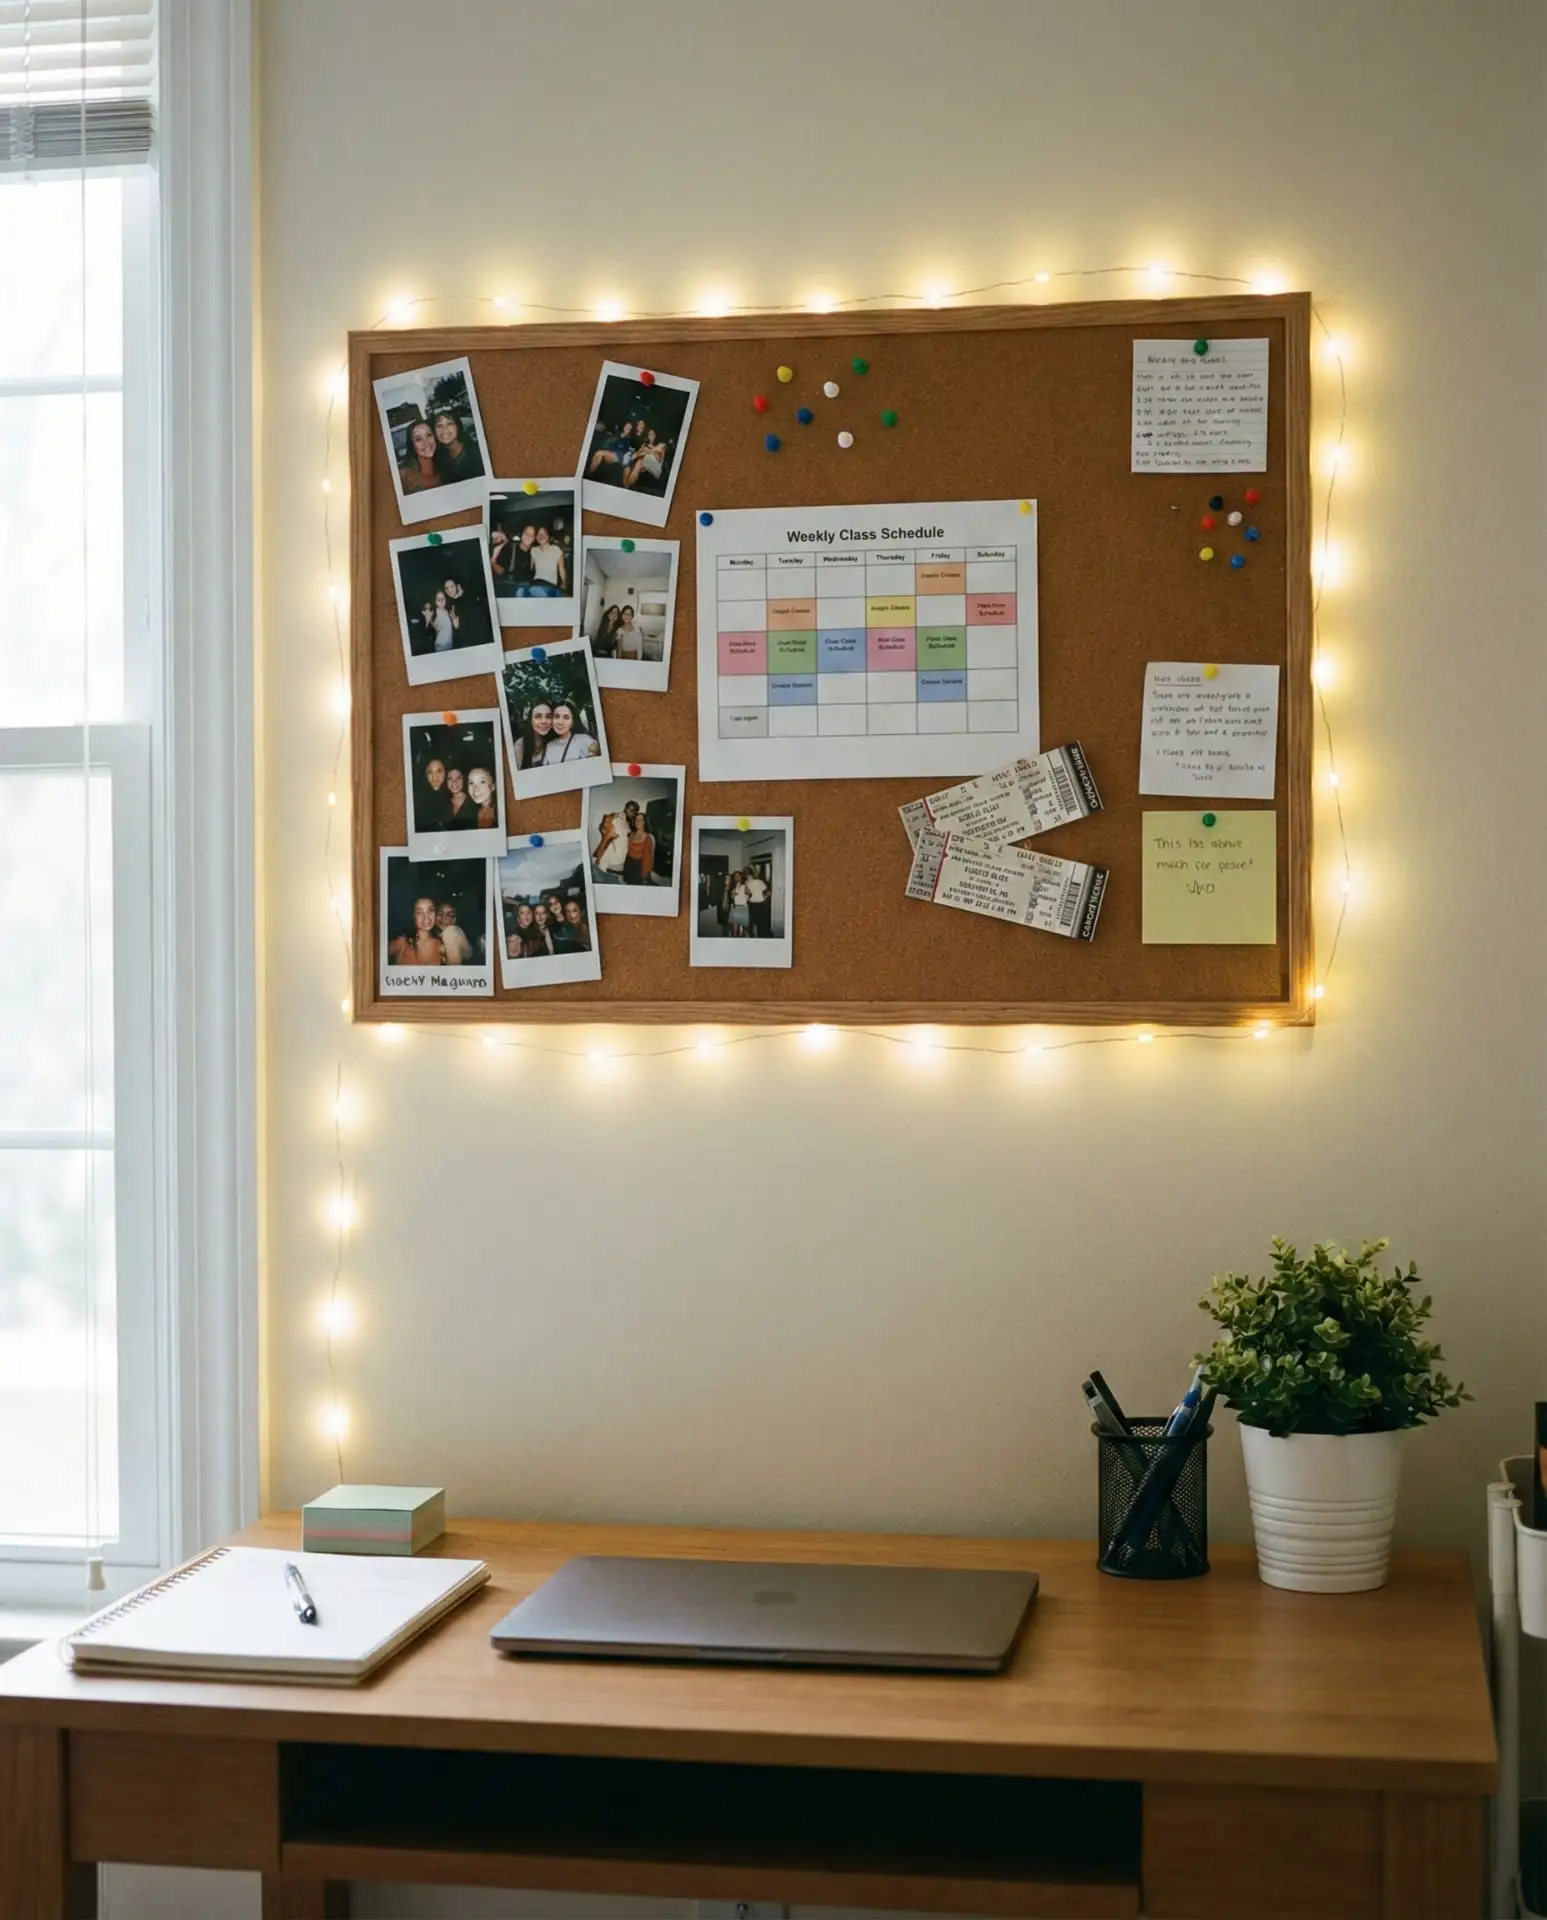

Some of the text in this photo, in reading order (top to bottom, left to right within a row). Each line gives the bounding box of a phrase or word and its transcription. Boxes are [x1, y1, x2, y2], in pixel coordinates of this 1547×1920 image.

[787, 526, 944, 544] Weekly Class Schedule
[778, 557, 804, 565] Tuesday
[823, 555, 858, 563] Wednesday
[876, 554, 905, 562] Thursday
[931, 552, 951, 560] Friday
[1153, 837, 1182, 849] This
[1156, 859, 1189, 870] much
[1194, 860, 1211, 872] for
